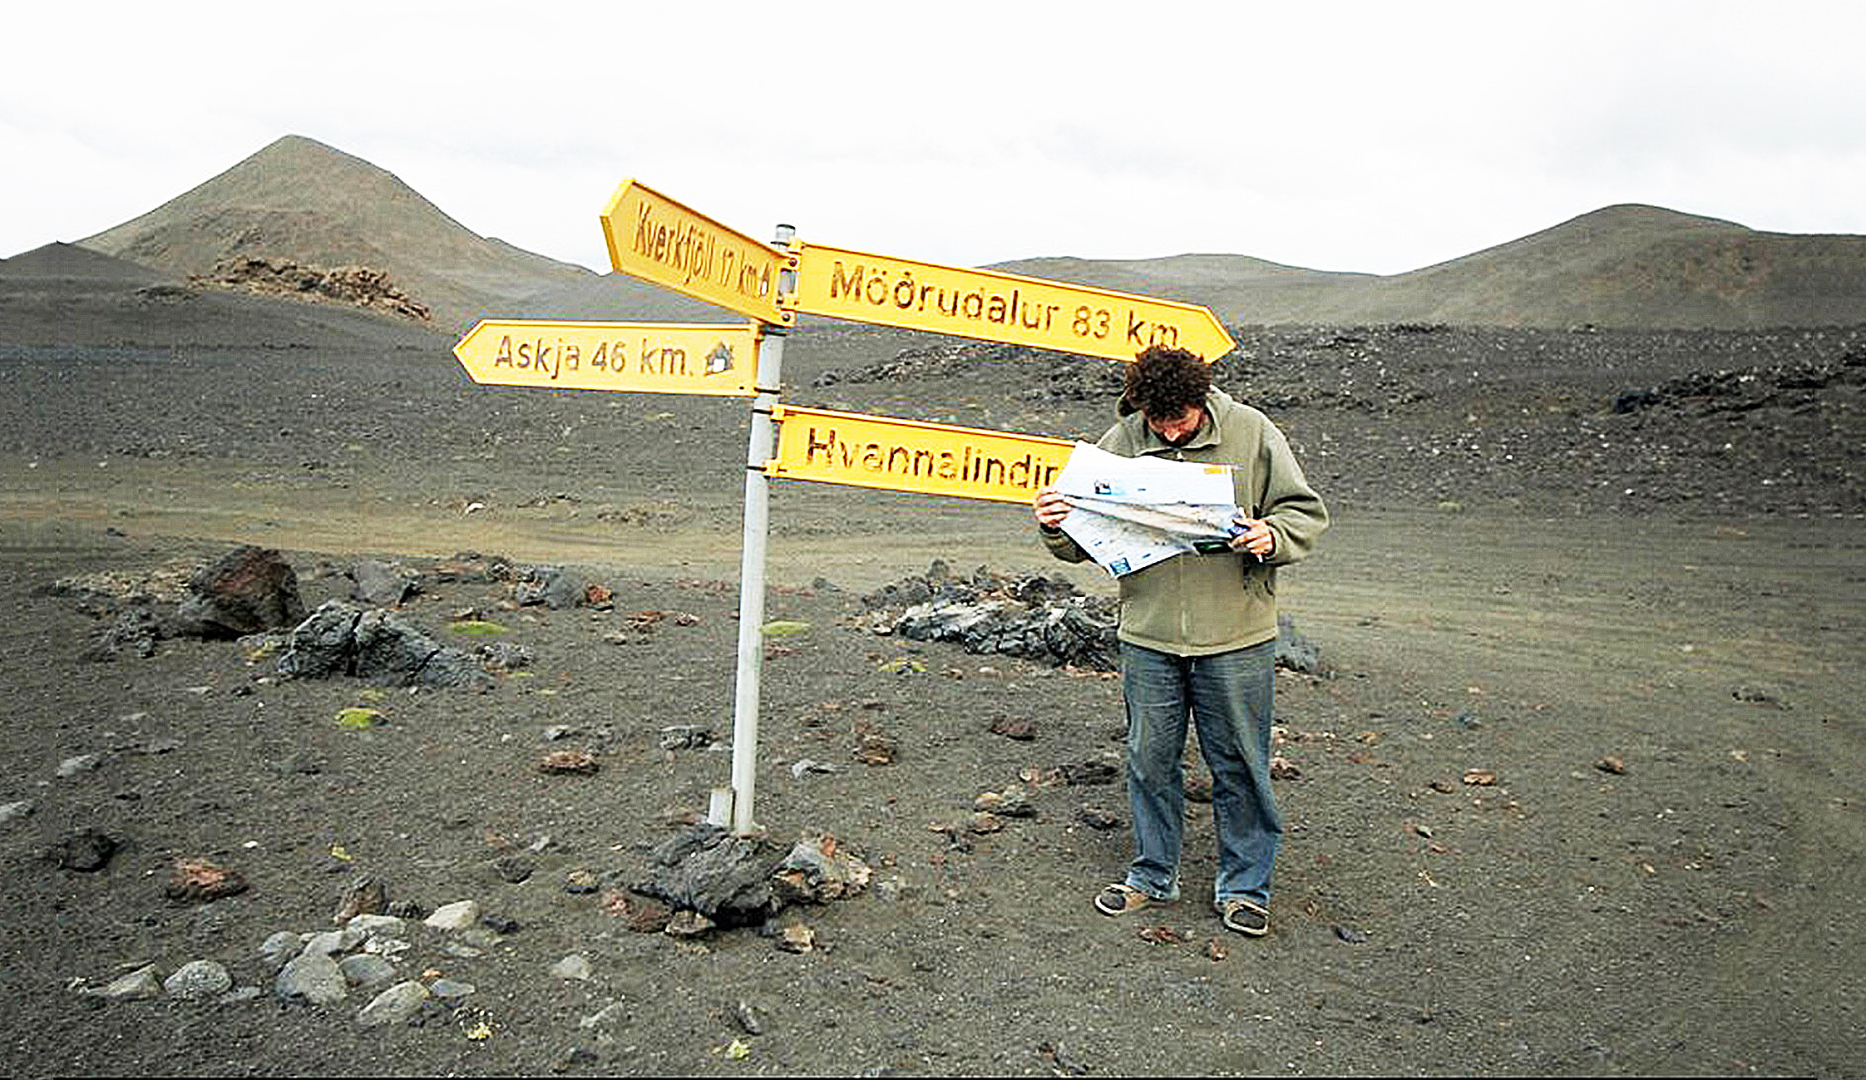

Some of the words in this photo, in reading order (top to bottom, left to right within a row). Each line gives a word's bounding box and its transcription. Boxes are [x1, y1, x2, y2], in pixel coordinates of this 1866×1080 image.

[633, 201, 715, 286] Kverkfjöll
[1071, 305, 1111, 339] 83
[494, 335, 580, 379] Askja
[591, 341, 626, 373] 46
[640, 338, 694, 377] km.
